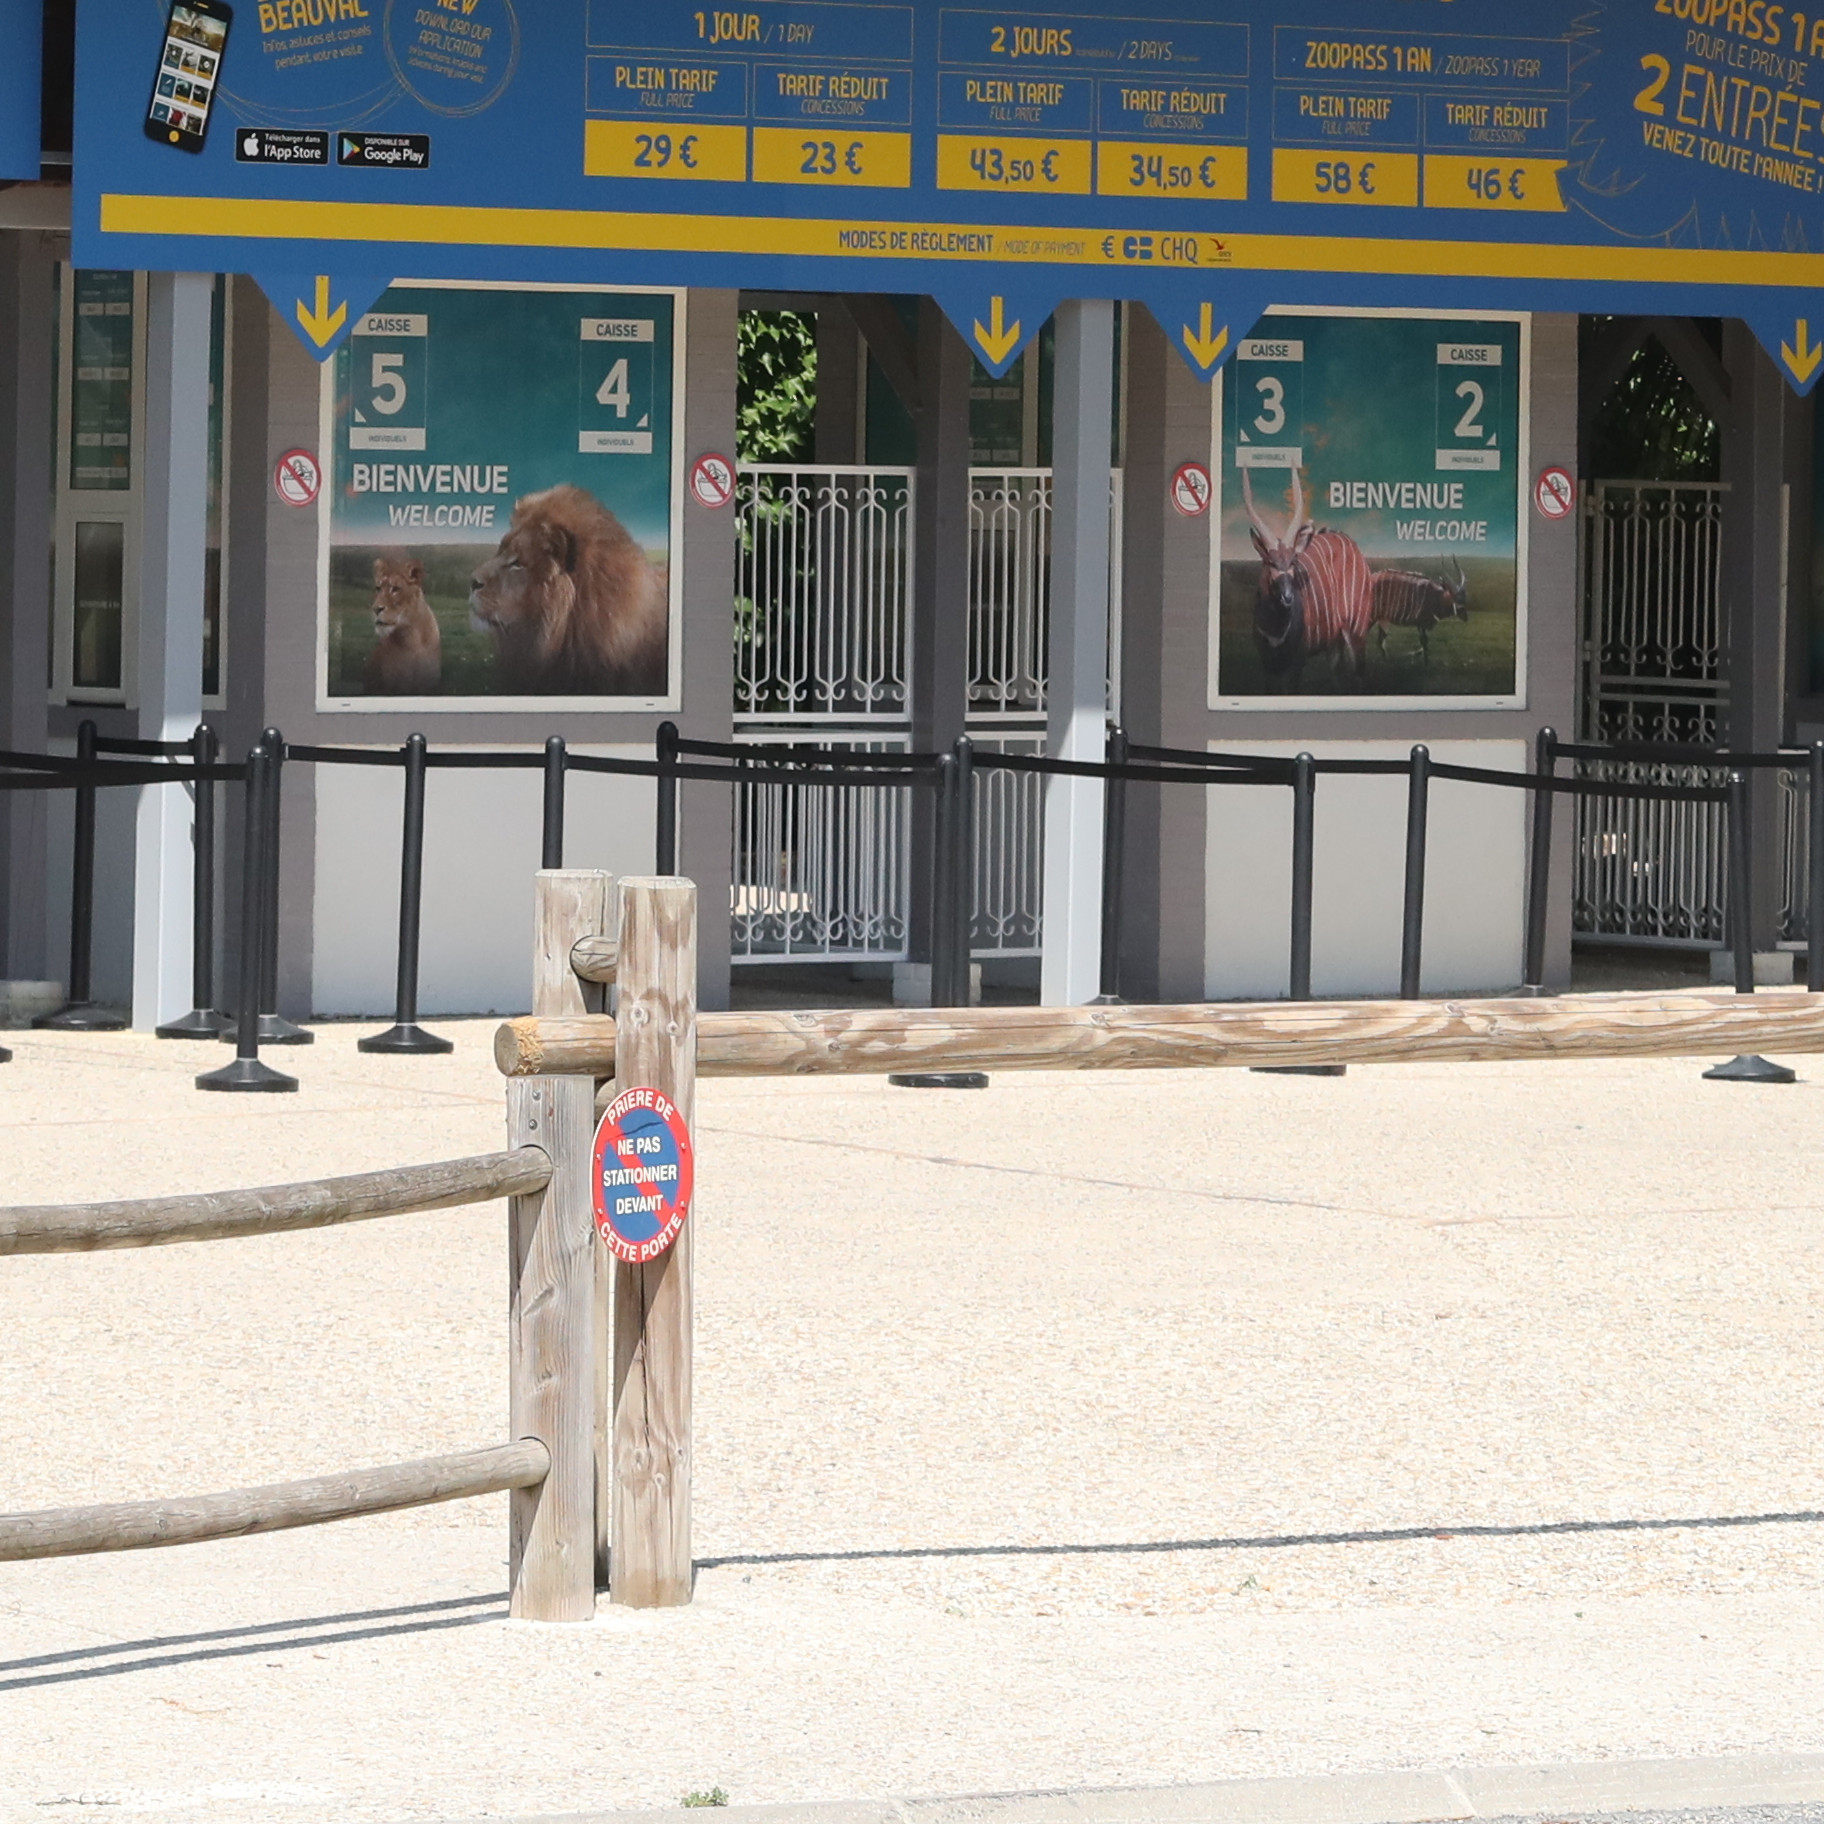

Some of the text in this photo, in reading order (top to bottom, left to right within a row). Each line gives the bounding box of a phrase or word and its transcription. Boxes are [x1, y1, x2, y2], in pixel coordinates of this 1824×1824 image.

[418, 29, 484, 58] APPLICATION
[693, 12, 815, 44] 1 JOUR 1 DAY
[990, 26, 1006, 53] 2
[1010, 27, 1073, 58] JOURS
[1128, 41, 1140, 60] 2
[1140, 40, 1174, 61] DAYS
[1791, 12, 1806, 52] 1
[1305, 41, 1388, 70] ZOOPASS
[1393, 47, 1402, 72] 1
[1407, 46, 1432, 72] AN
[1445, 55, 1500, 77] ZOOPASS
[1511, 58, 1542, 78] YEAR
[1685, 29, 1809, 87] POUR LE PRIX DE
[616, 66, 719, 92] PLEIN TARIF
[777, 71, 889, 100] TARIF RÉDUIT
[966, 80, 1065, 106] PLEIN TARIF
[1633, 53, 1671, 116] 2
[1121, 86, 1227, 115] TARIF RÉDUIT
[1299, 95, 1392, 120] PLEIN TARIF
[1446, 101, 1549, 128] TARIF RÉDUIT
[293, 145, 322, 159] Store
[364, 146, 425, 165] Google Play
[634, 134, 699, 168] 29 €
[800, 141, 864, 175] 23 €
[1643, 120, 1697, 159] VENEZ
[1699, 137, 1753, 174] TOUTE
[970, 148, 1060, 184] 43,50 €
[1129, 154, 1217, 190] 34,50 €
[1315, 161, 1376, 195] 58 €
[1467, 168, 1525, 200] 46 €
[839, 230, 887, 251] MODES
[890, 232, 909, 251] DE
[911, 228, 994, 253] RÈGLEMENT
[1160, 237, 1199, 265] CHQ
[367, 318, 411, 333] CAISSE
[596, 322, 639, 338] CAISSE
[1250, 343, 1289, 358] CAISSE
[1450, 347, 1488, 362] CAISSE
[371, 353, 407, 416] 5
[595, 358, 631, 419] 4
[1253, 376, 1286, 435] 3
[1453, 380, 1485, 439] 2
[352, 463, 509, 494] BIENVENUE
[1329, 481, 1464, 510] BIENVENUE
[389, 504, 495, 528] WELCOME
[1395, 520, 1487, 542] WELCOME
[606, 1090, 674, 1126] PRIERE DE
[617, 1136, 661, 1156] NE PAS
[603, 1164, 678, 1187] STATIONNER
[616, 1194, 664, 1215] DEVANT
[600, 1213, 683, 1262] CETTE PORTE
